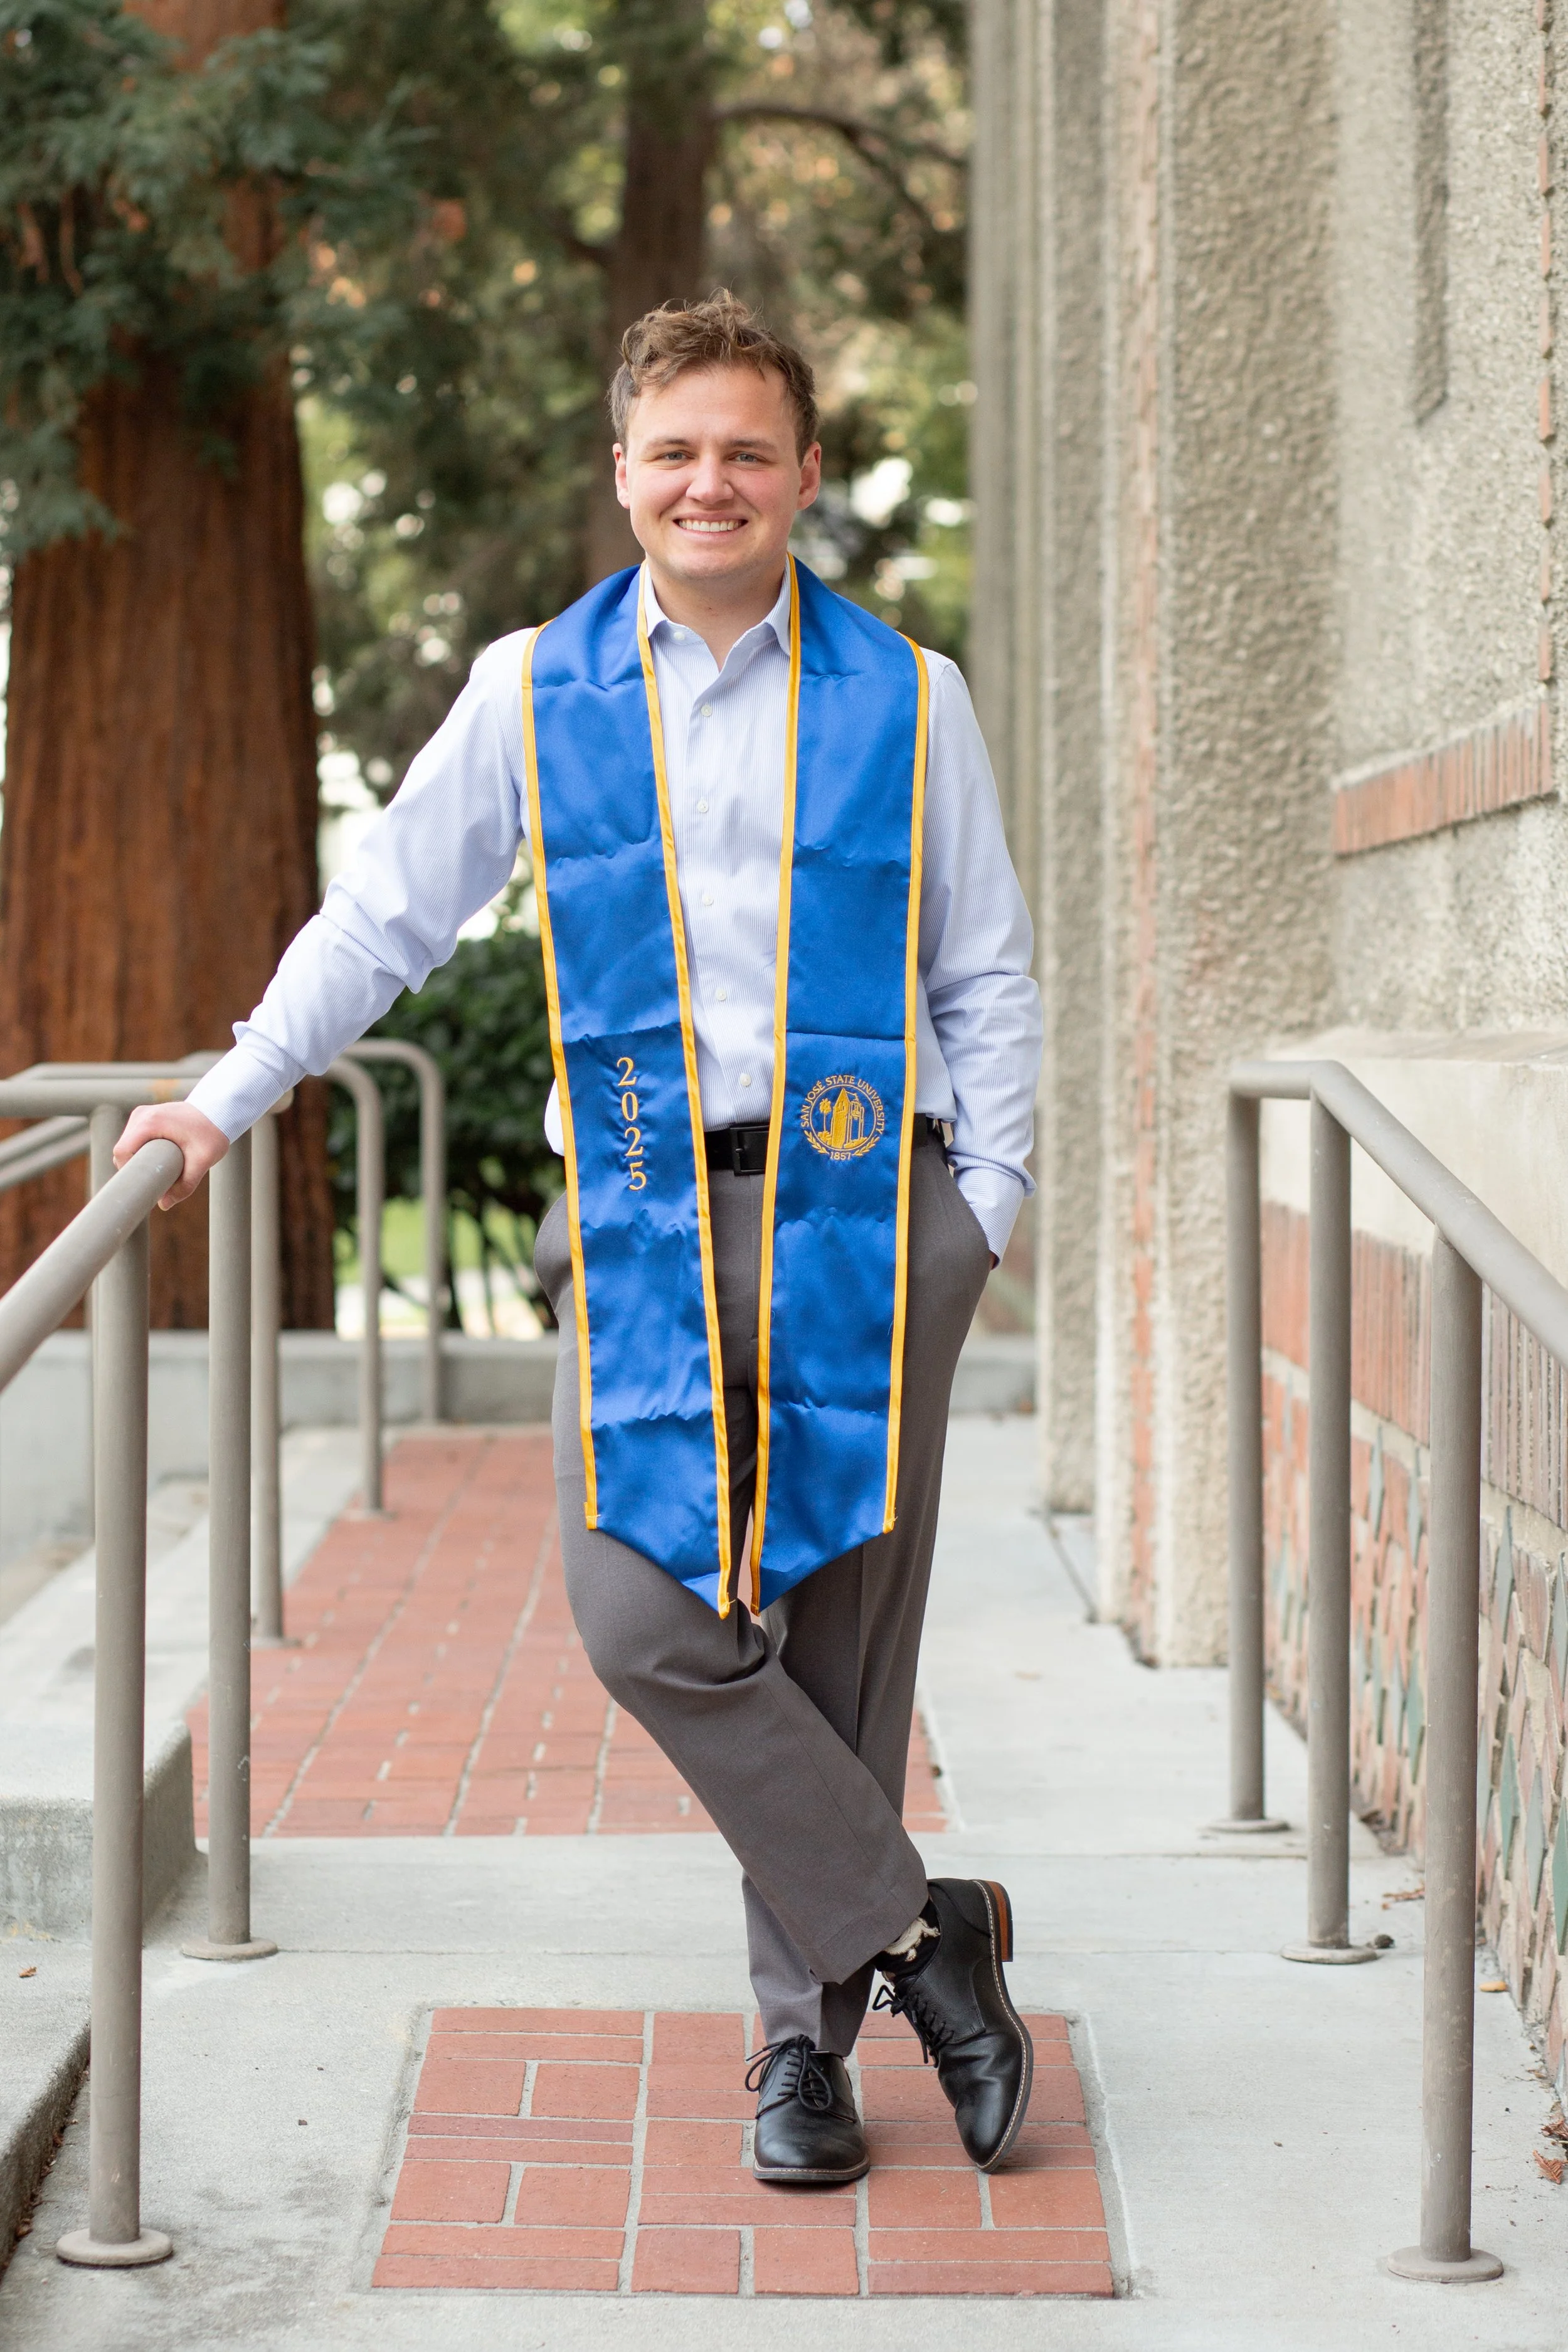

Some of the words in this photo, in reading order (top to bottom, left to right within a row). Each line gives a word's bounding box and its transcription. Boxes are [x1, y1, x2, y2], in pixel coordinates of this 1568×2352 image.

[617, 1057, 647, 1190] 2025
[800, 1104, 809, 1128] SAN
[825, 1074, 856, 1086] STATE
[857, 1079, 885, 1135] UNIVERSITY
[830, 1152, 852, 1160] 1857
